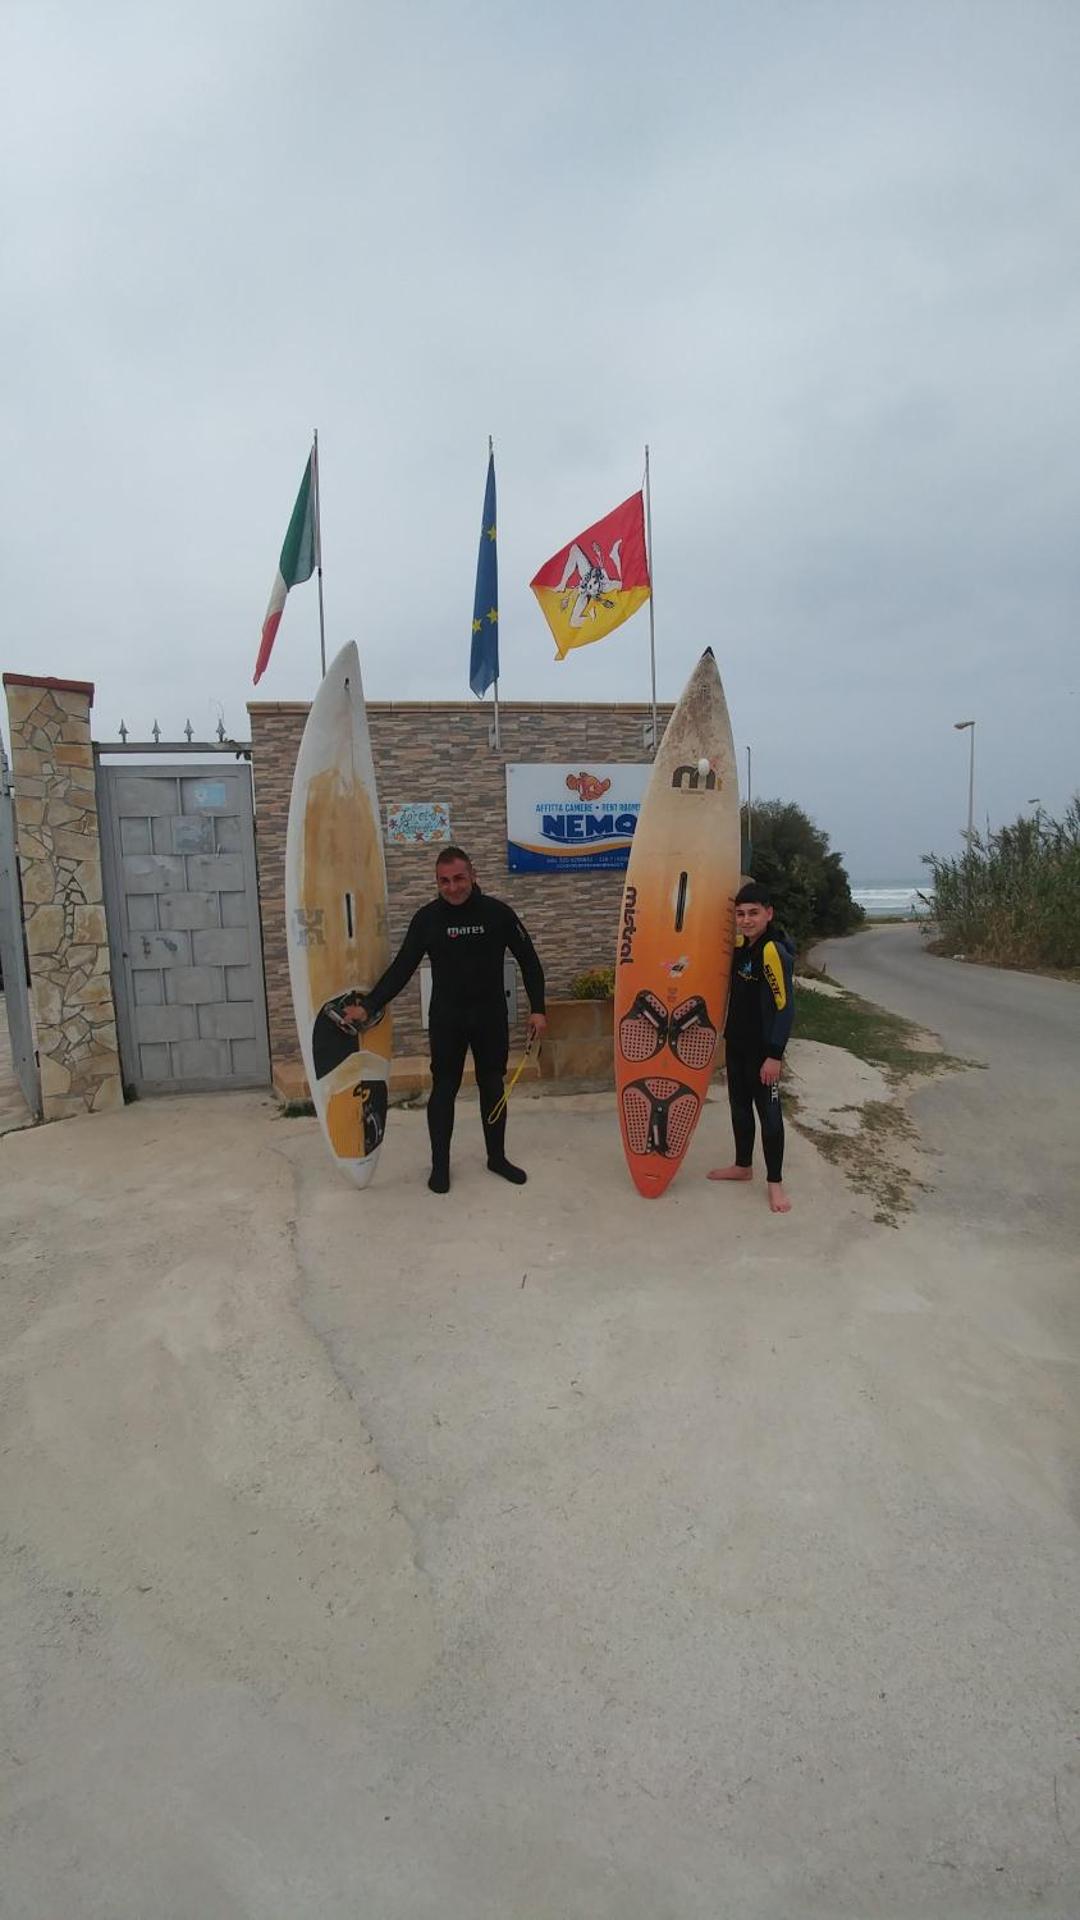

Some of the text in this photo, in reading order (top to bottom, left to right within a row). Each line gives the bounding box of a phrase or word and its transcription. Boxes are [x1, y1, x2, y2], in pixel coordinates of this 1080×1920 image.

[535, 803, 563, 813] AFFITTA
[565, 803, 593, 813] CAMERE
[543, 814, 637, 837] NEMO
[446, 925, 485, 936] mares
[620, 886, 637, 966] mistral
